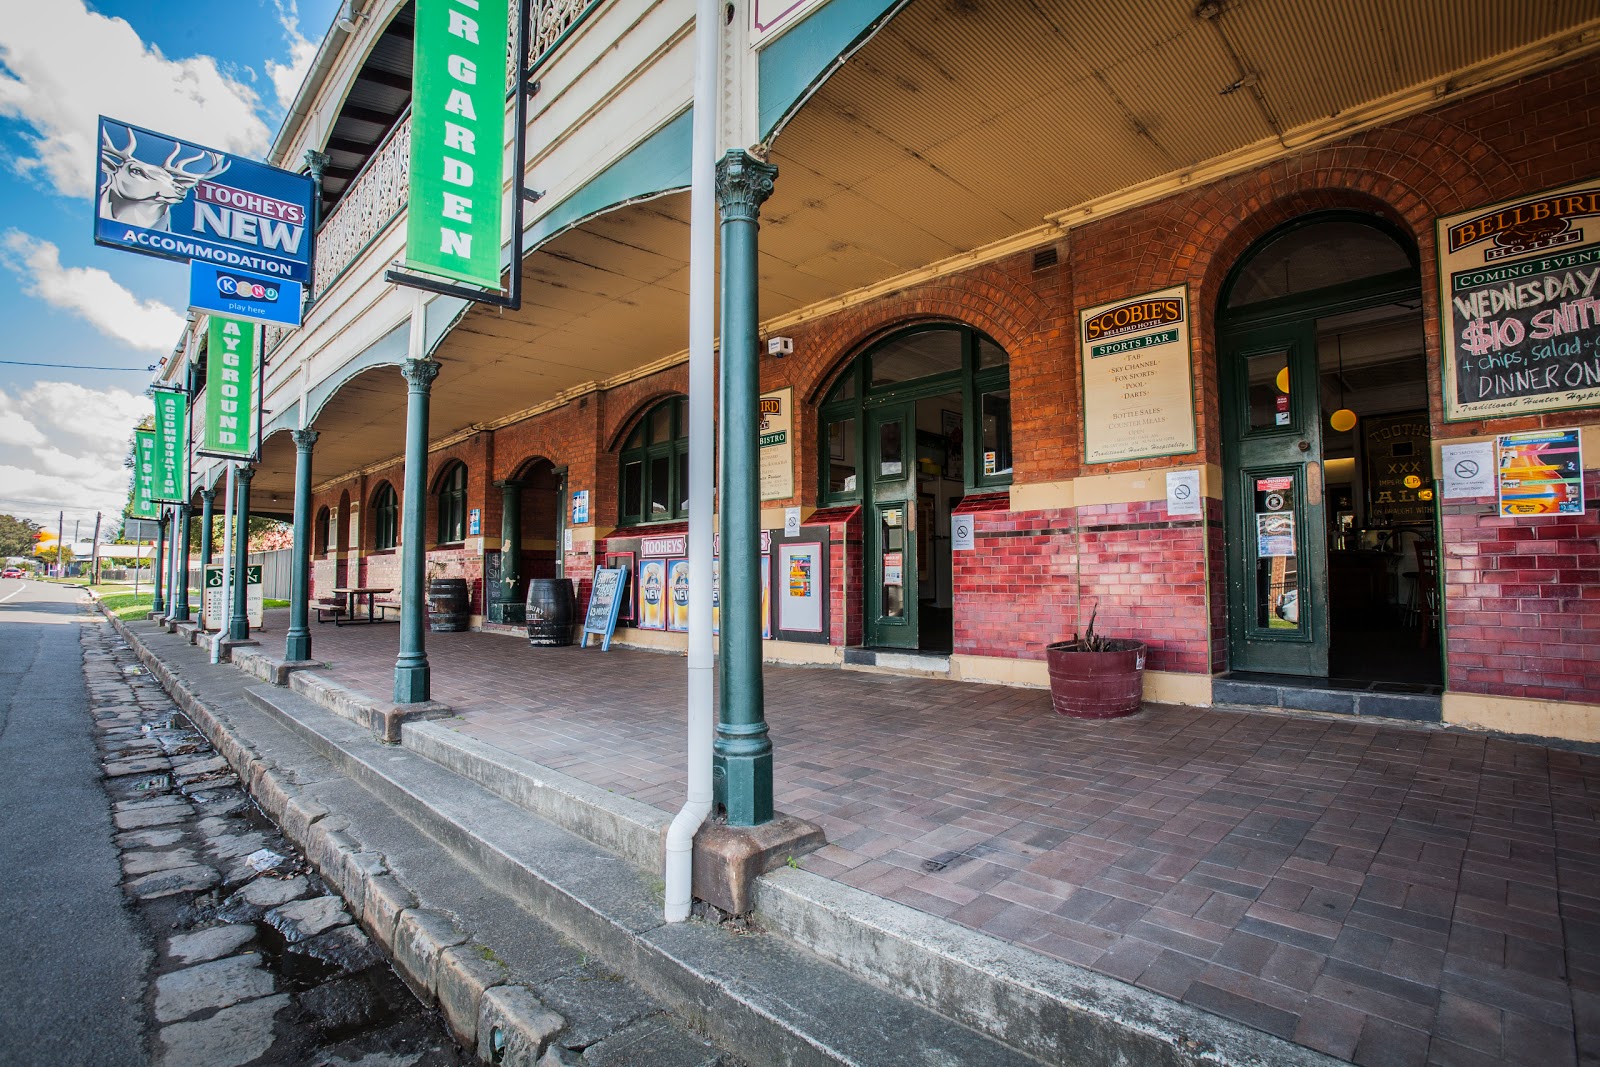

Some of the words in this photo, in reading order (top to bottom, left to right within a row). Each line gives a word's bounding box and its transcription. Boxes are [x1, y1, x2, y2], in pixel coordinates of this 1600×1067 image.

[439, 54, 479, 260] GARDEN
[201, 183, 300, 221] TOOHEYS
[192, 200, 305, 254] NEW
[123, 229, 292, 276] ACCOMMODATION
[1491, 234, 1576, 259] HOTEL
[217, 276, 278, 300] KENO
[1460, 264, 1533, 286] COMING
[229, 303, 246, 313] play
[247, 305, 266, 315] here
[1453, 267, 1600, 320] WEDNESDAY
[1088, 301, 1179, 339] SCOBIE'S
[1103, 324, 1137, 336] BELLBIRD
[1138, 319, 1162, 329] HOTEL
[1460, 317, 1526, 356] $10
[1100, 340, 1141, 355] SPORTS
[1145, 333, 1169, 345] BAR
[1479, 364, 1559, 398] DINNER
[1460, 400, 1518, 413] Traditional
[164, 398, 177, 495] ACCOMMODATION
[140, 438, 154, 511] BISTRO
[644, 539, 683, 554] TOOHEYS
[644, 589, 661, 601] NEW
